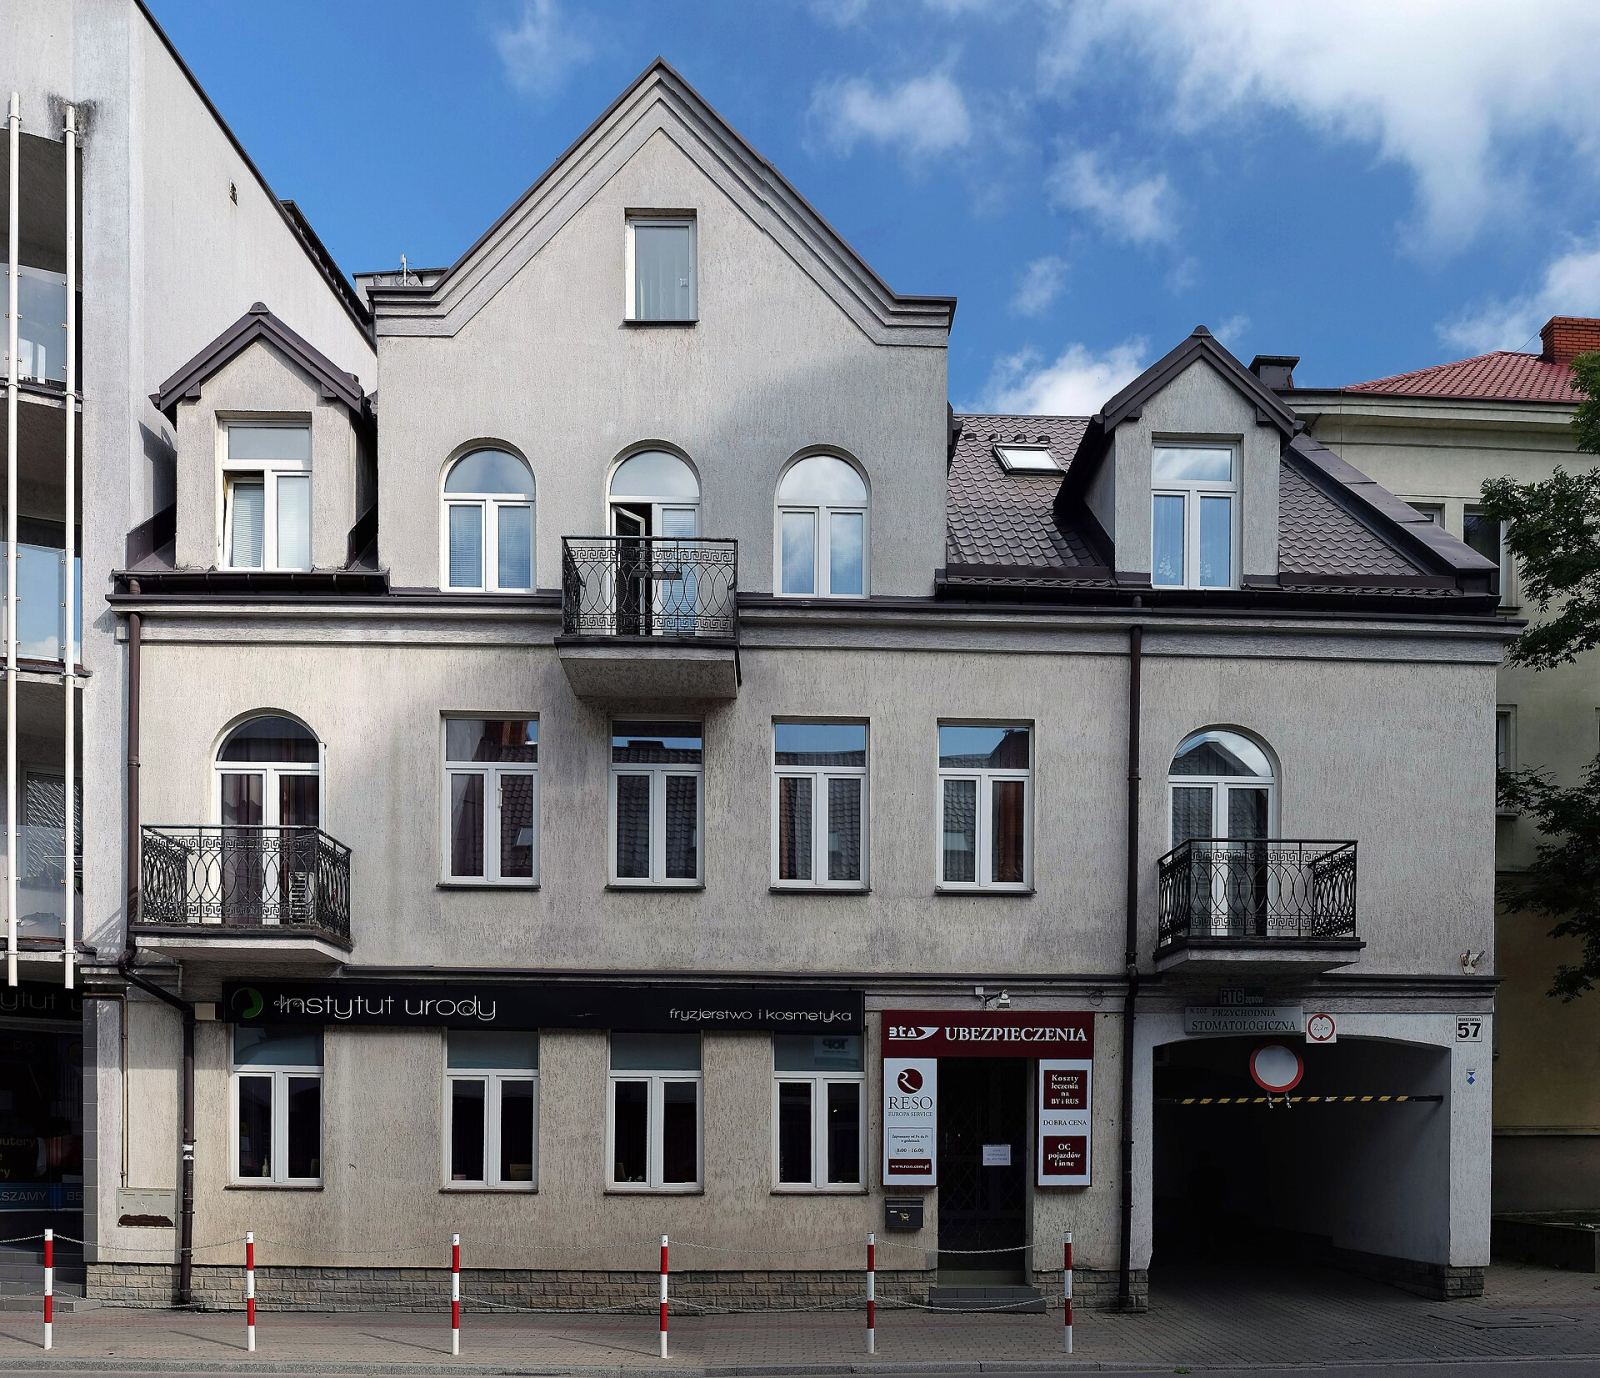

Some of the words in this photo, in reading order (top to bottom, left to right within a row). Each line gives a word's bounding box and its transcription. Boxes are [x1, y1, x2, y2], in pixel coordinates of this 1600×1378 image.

[1221, 989, 1243, 1004] RTG
[274, 994, 394, 1020] Instytut
[405, 995, 496, 1022] urody
[1211, 1009, 1276, 1018] PRZYCHODNIA
[669, 1008, 753, 1023] fryzjerstwo
[757, 1008, 761, 1021] i
[765, 1009, 852, 1024] kosmetyka
[1191, 1020, 1296, 1032] STOMATOLOGICZNA
[1457, 1022, 1481, 1038] 57
[944, 1027, 1087, 1042] UBEZPIECZENIA
[1051, 1074, 1079, 1083] Koszty
[1051, 1082, 1079, 1090] leczenia
[888, 1096, 933, 1110] RESO
[1058, 1143, 1071, 1151] OC
[1048, 1151, 1081, 1161] pojazdów
